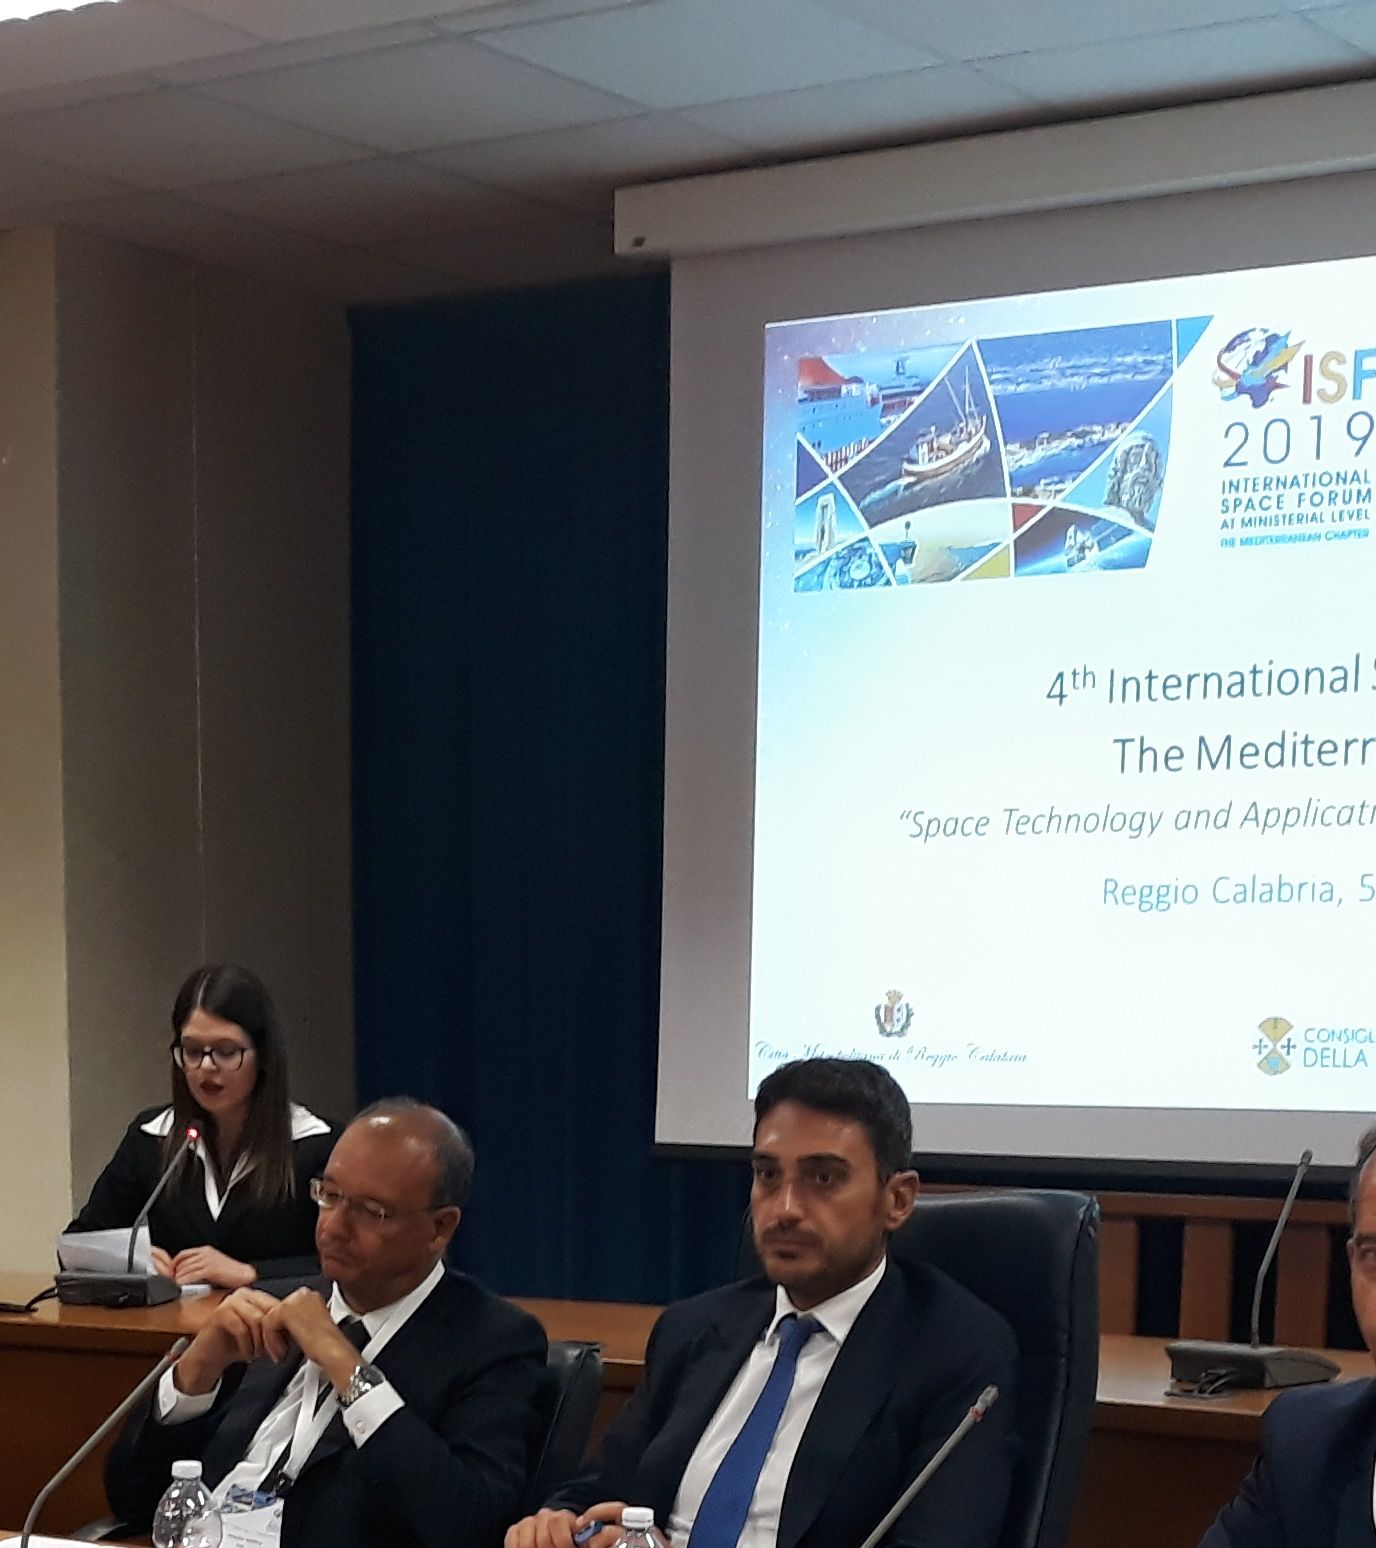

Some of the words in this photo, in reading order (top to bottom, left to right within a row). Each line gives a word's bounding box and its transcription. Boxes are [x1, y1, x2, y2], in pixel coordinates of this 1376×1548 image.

[1222, 410, 1374, 468] 2019
[1220, 493, 1285, 514] SPACE
[1297, 487, 1372, 508] FORUM
[1221, 468, 1371, 495] INTERNATIONAL
[1220, 517, 1235, 530] AT
[1240, 512, 1325, 529] MINISTERIAL
[1331, 508, 1370, 523] LEVEL
[1046, 664, 1096, 707] 4th
[1108, 652, 1360, 704] International
[1113, 734, 1185, 775] The
[1002, 803, 1163, 840] Technology
[1174, 800, 1233, 830] and
[1102, 876, 1199, 913] Reggio
[1211, 873, 1344, 908] Calabria,
[1358, 872, 1376, 903] 5
[1303, 1047, 1368, 1068] DELLA
